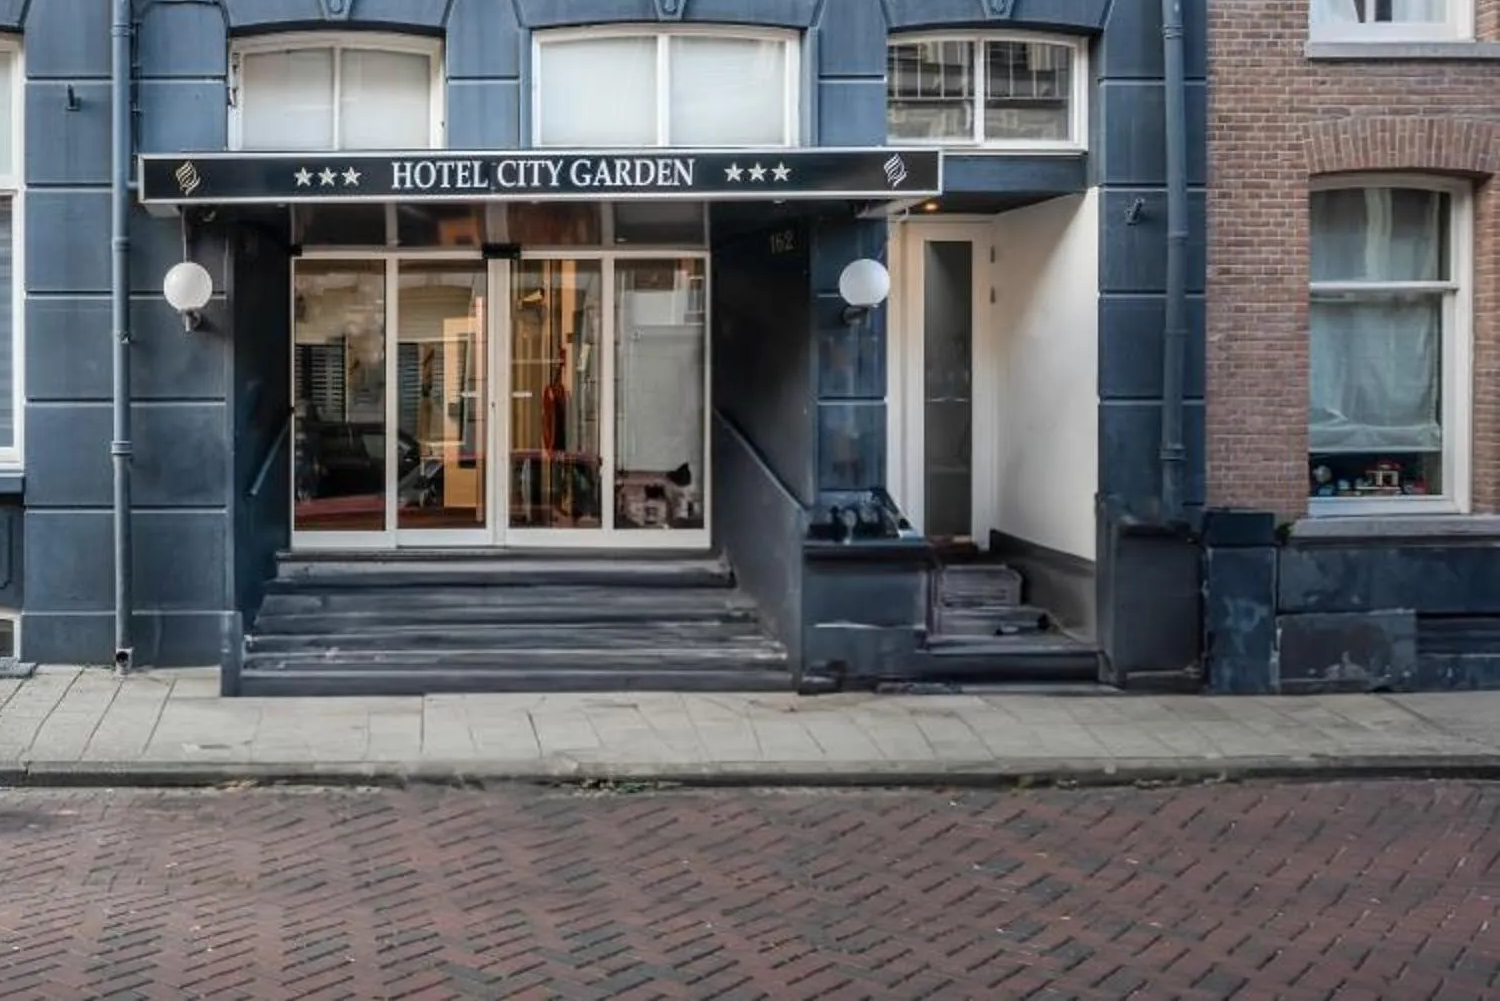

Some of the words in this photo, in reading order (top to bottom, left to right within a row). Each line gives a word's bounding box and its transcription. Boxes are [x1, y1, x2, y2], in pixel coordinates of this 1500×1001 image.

[391, 160, 489, 189] HOTEL
[497, 159, 564, 187] CITY
[569, 158, 695, 187] GARDEN
